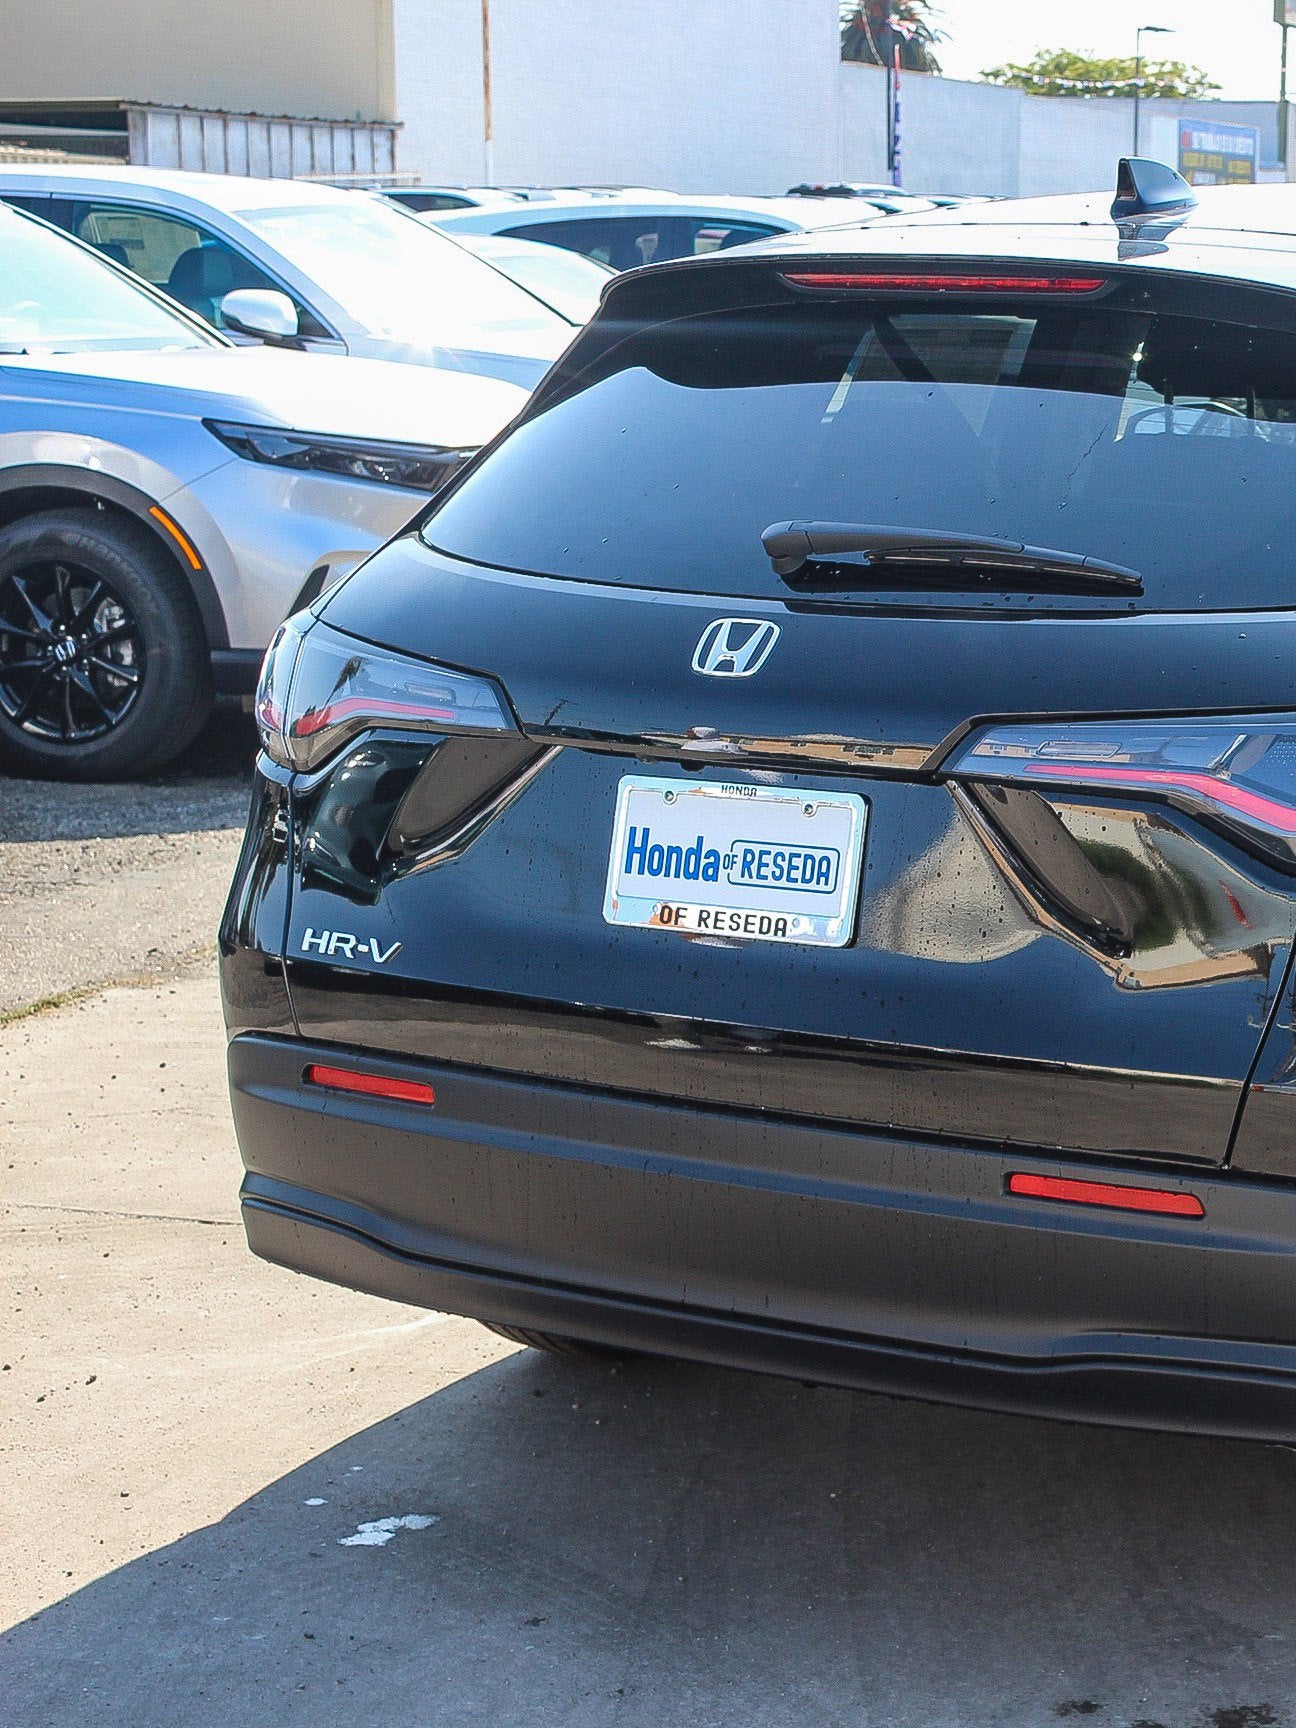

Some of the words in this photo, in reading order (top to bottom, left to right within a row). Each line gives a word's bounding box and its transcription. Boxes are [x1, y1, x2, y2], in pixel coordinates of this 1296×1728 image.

[720, 784, 758, 798] HONDA
[624, 826, 721, 883] Honda
[722, 853, 739, 871] OF
[740, 848, 832, 887] RESEDA
[658, 904, 689, 926] OF
[697, 908, 789, 938] RESEDA
[301, 927, 402, 963] HR-V
